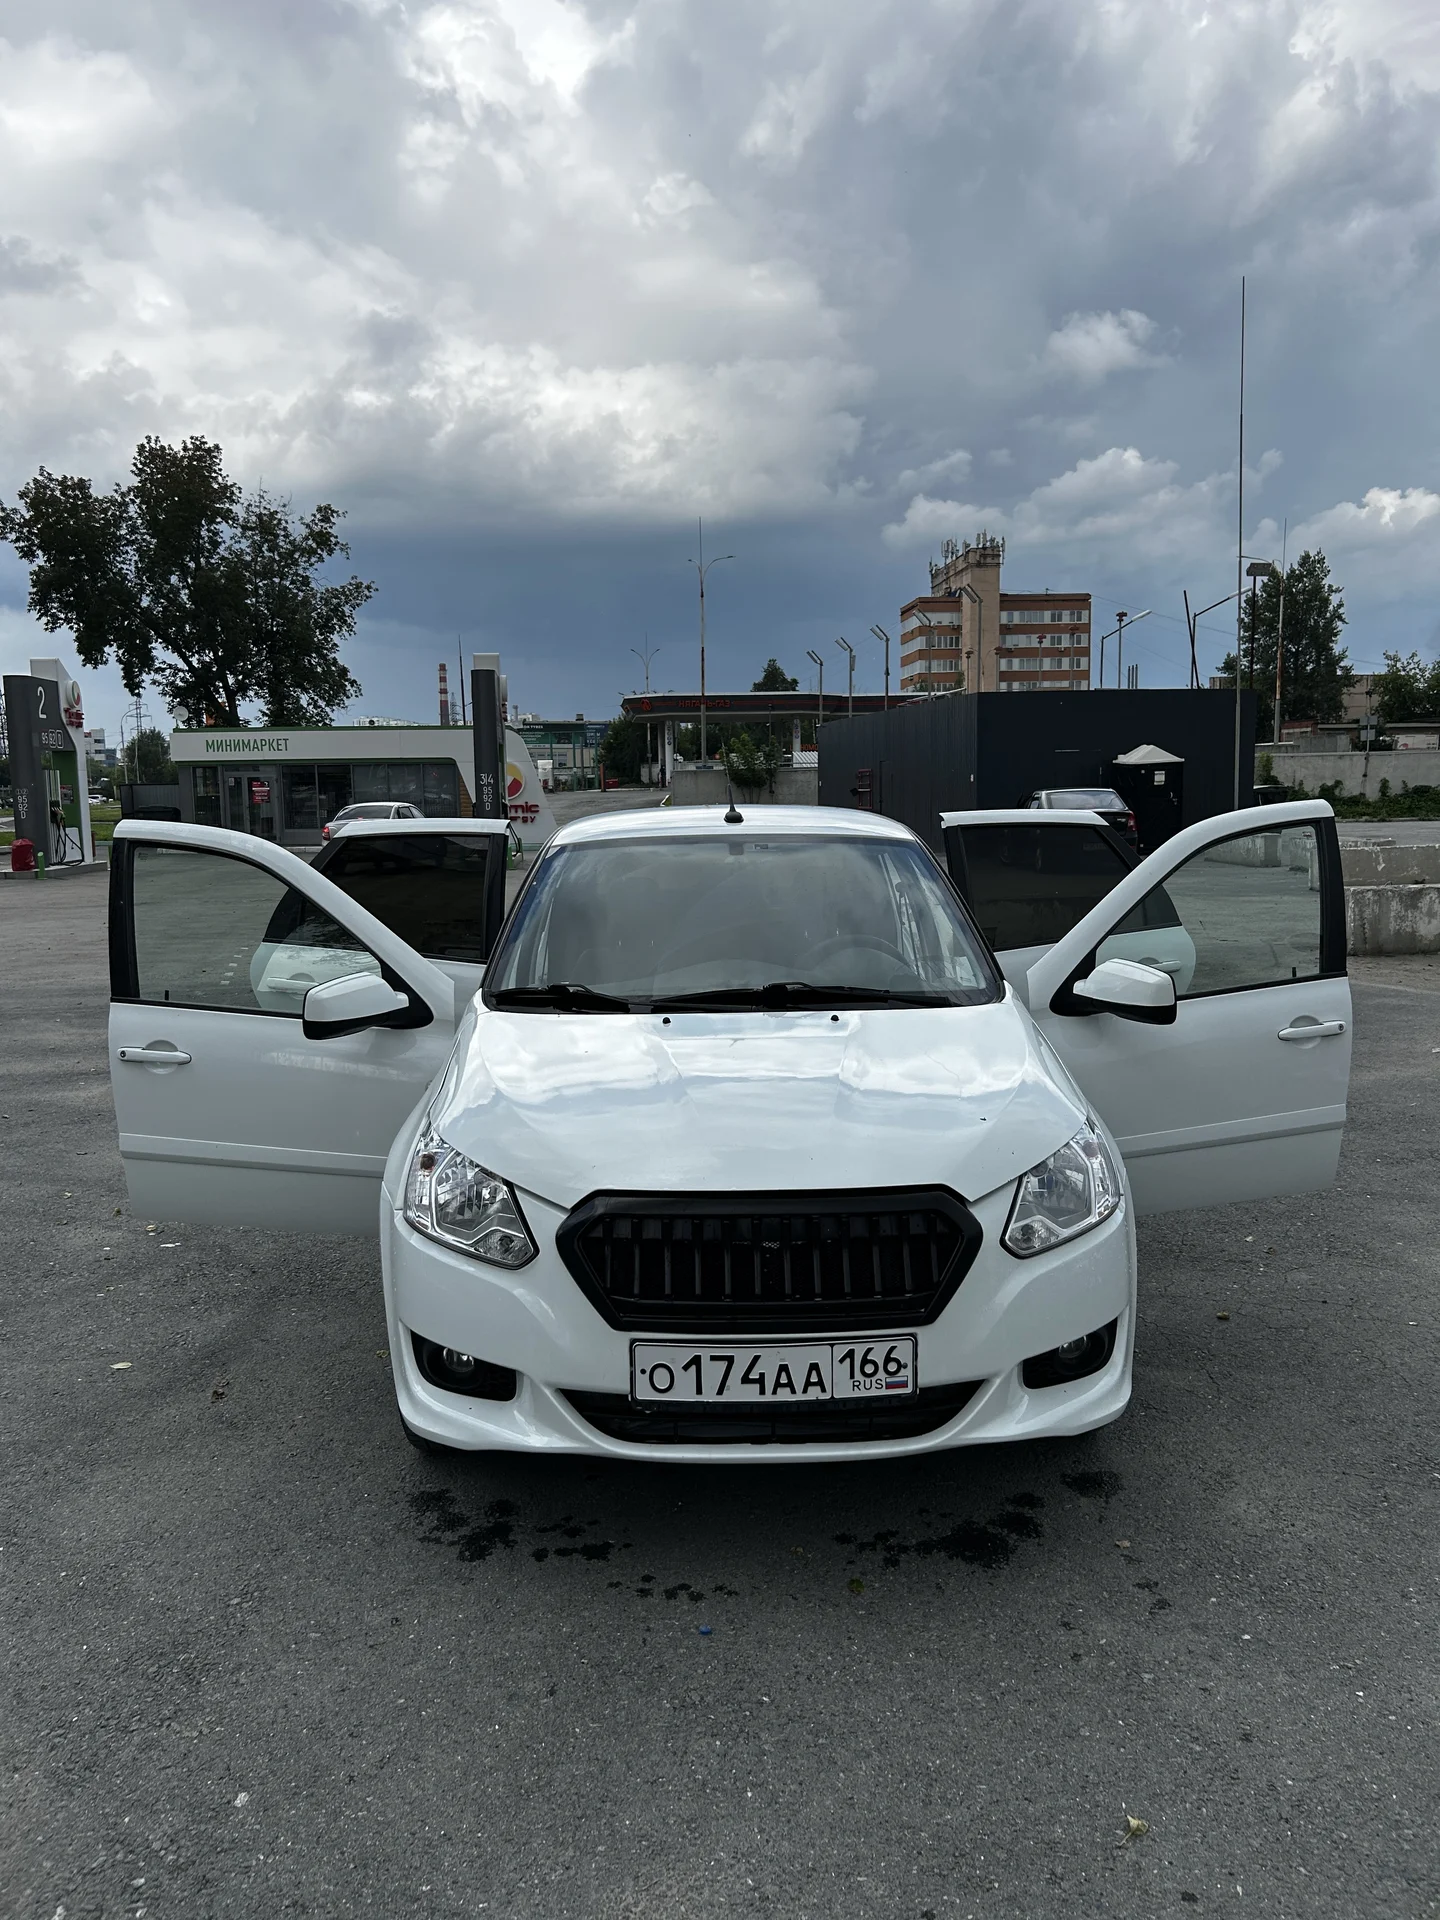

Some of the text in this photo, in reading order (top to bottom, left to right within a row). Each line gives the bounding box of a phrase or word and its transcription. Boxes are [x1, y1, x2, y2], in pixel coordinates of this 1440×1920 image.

[37, 686, 47, 719] 2
[41, 732, 48, 744] 95
[205, 738, 289, 752] МИНИМАРКЕТ
[483, 786, 493, 794] 95
[17, 795, 28, 803] 95
[483, 794, 493, 803] 92
[18, 803, 28, 811] 92
[838, 1345, 902, 1380] 166
[852, 1378, 884, 1392] RUS
